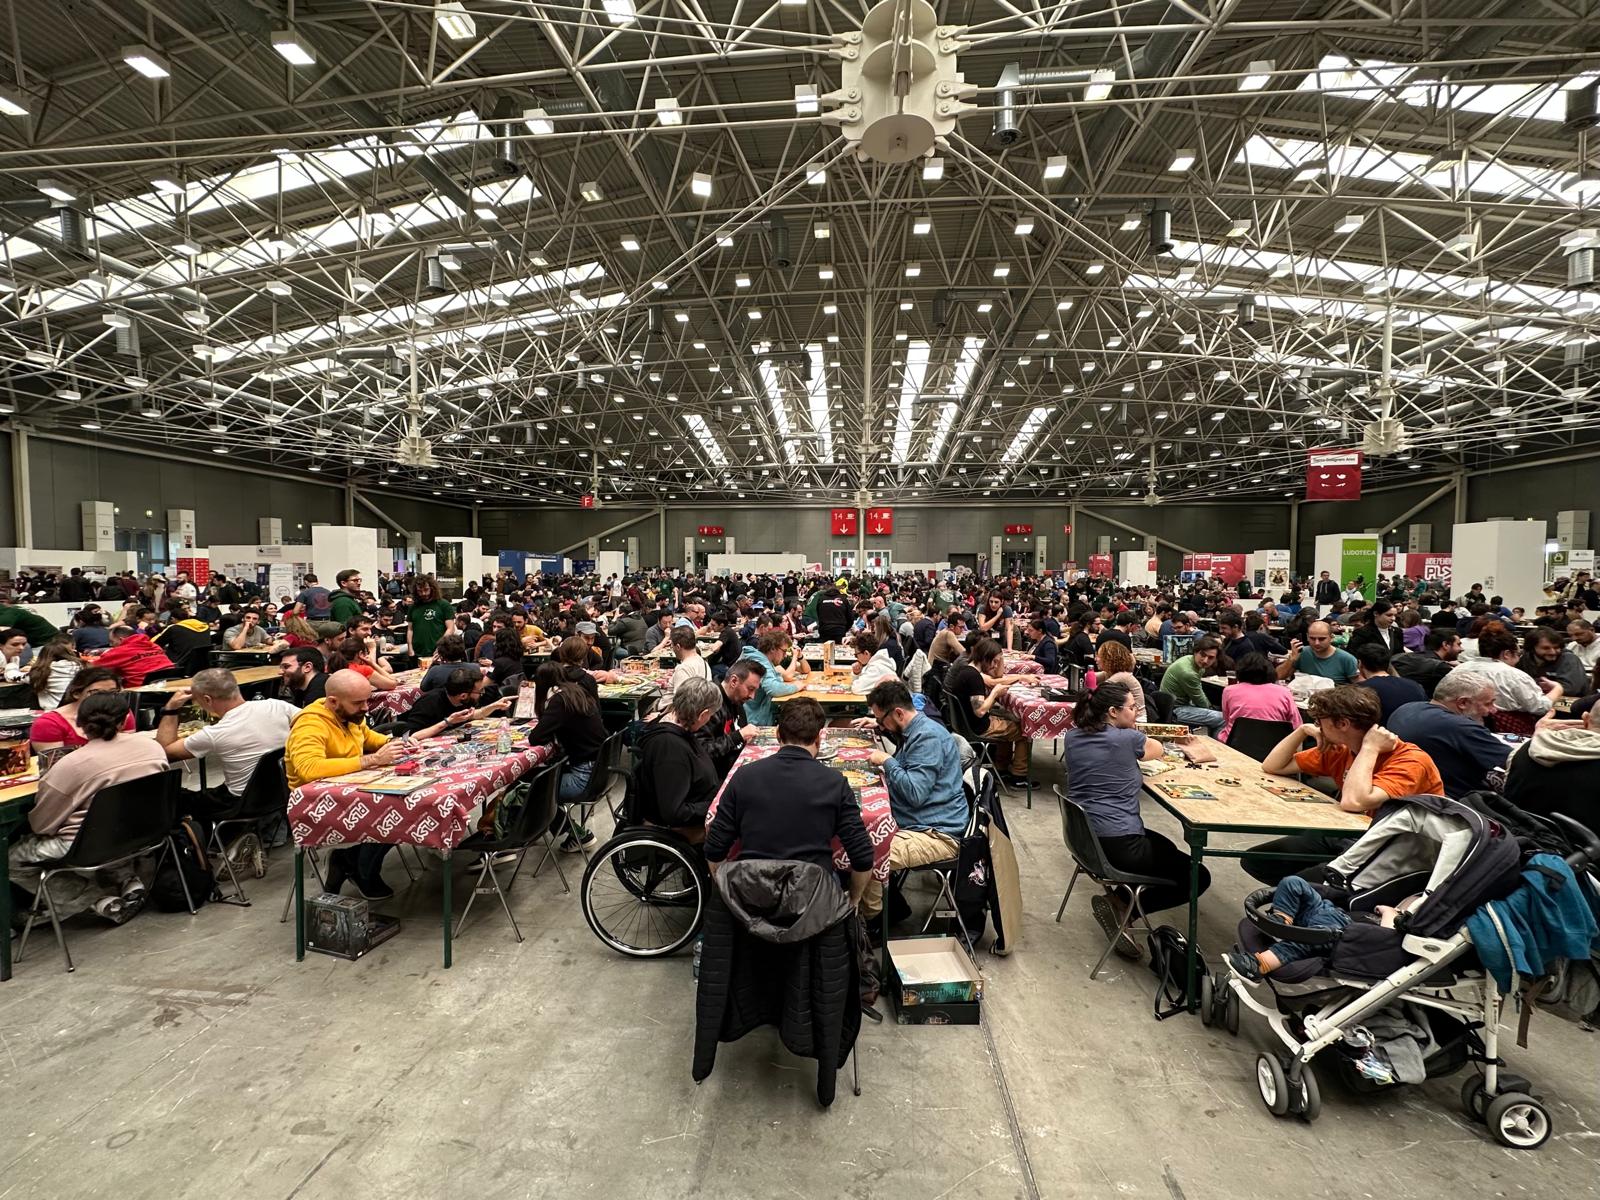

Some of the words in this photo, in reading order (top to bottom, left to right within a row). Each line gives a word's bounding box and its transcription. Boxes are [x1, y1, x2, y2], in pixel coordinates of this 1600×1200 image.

[585, 497, 590, 506] F
[834, 512, 843, 520] 14
[869, 512, 878, 520] 14
[1064, 525, 1071, 533] H
